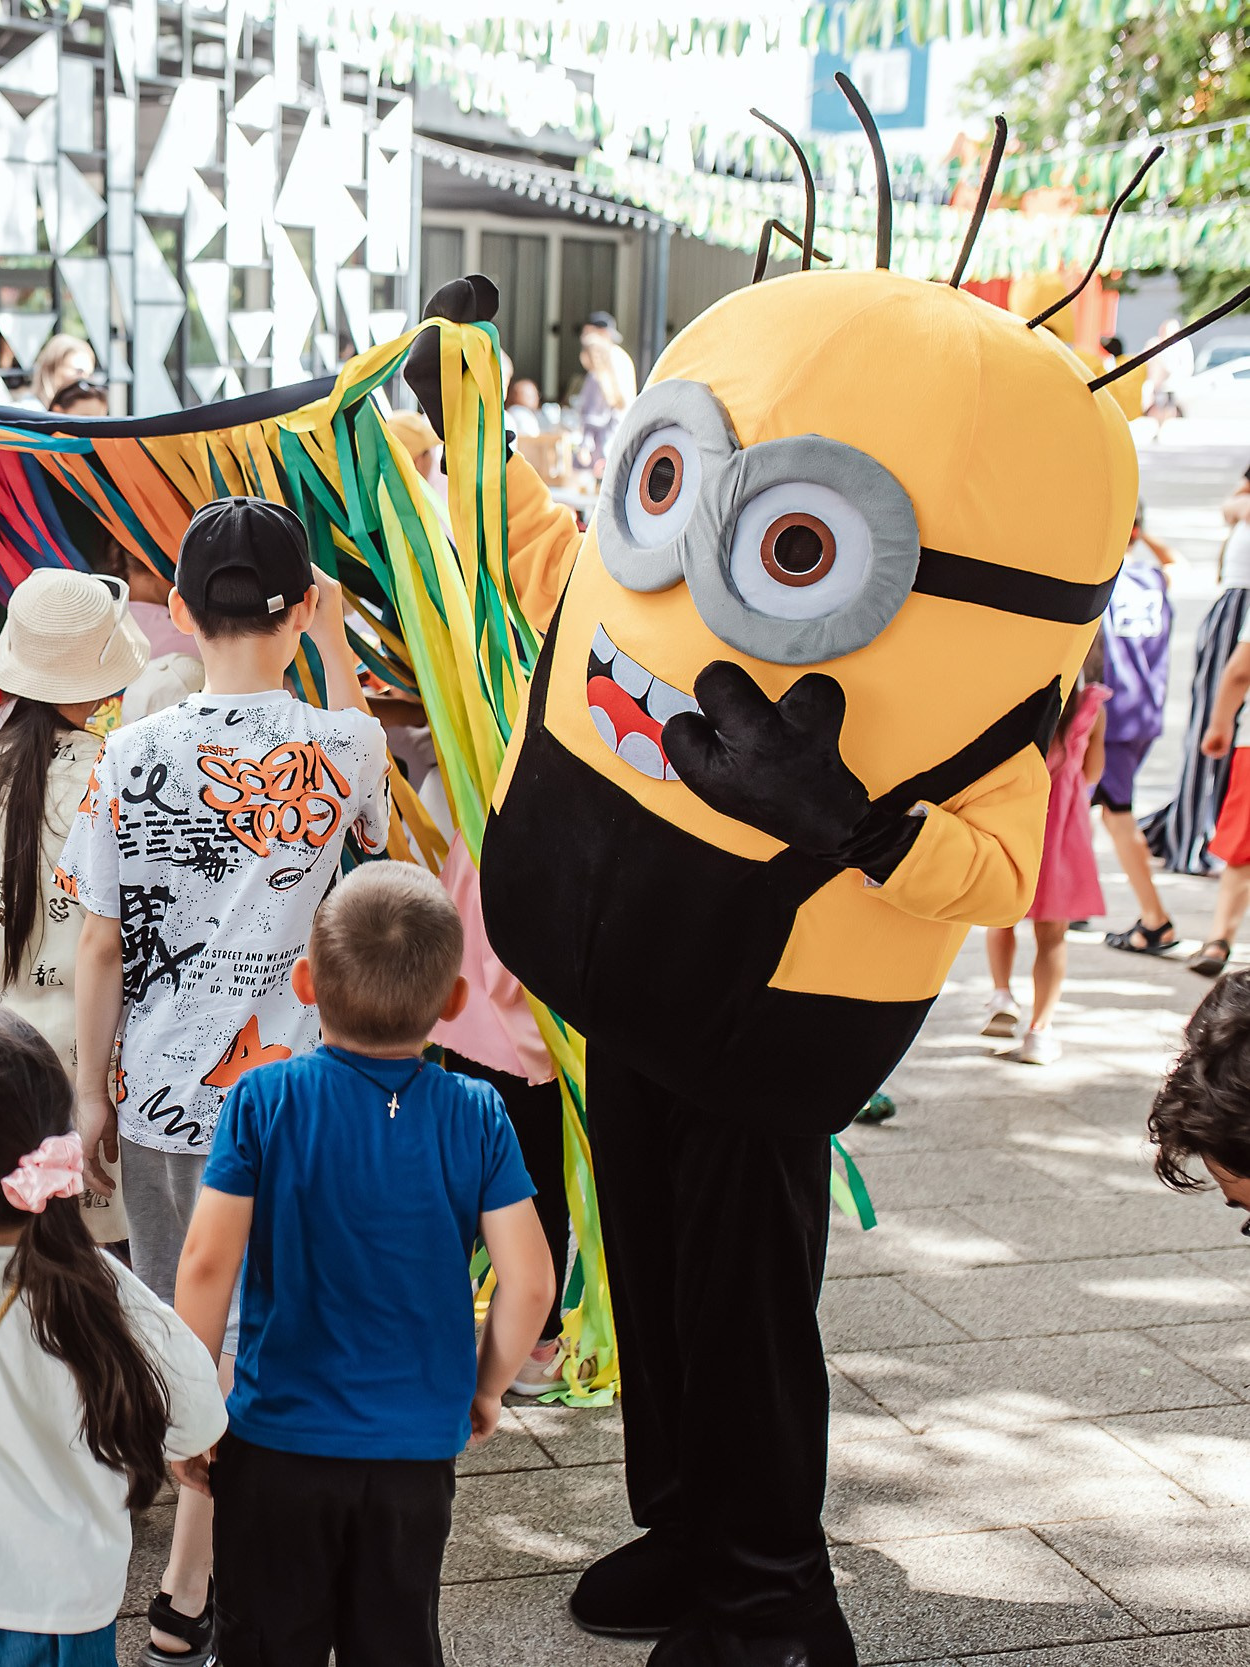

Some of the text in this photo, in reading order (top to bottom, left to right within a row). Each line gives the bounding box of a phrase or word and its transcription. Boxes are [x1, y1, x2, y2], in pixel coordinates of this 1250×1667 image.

[169, 945, 178, 953] IS
[211, 949, 243, 961] STREET
[245, 952, 263, 962] AND
[266, 953, 279, 962] WE
[279, 949, 293, 961] ARE
[30, 964, 64, 987] 龍
[233, 963, 270, 975] EXPLAIN
[233, 974, 257, 986] WORK
[210, 985, 223, 995] UP.
[228, 986, 244, 997] YOU
[251, 987, 268, 998] CAN
